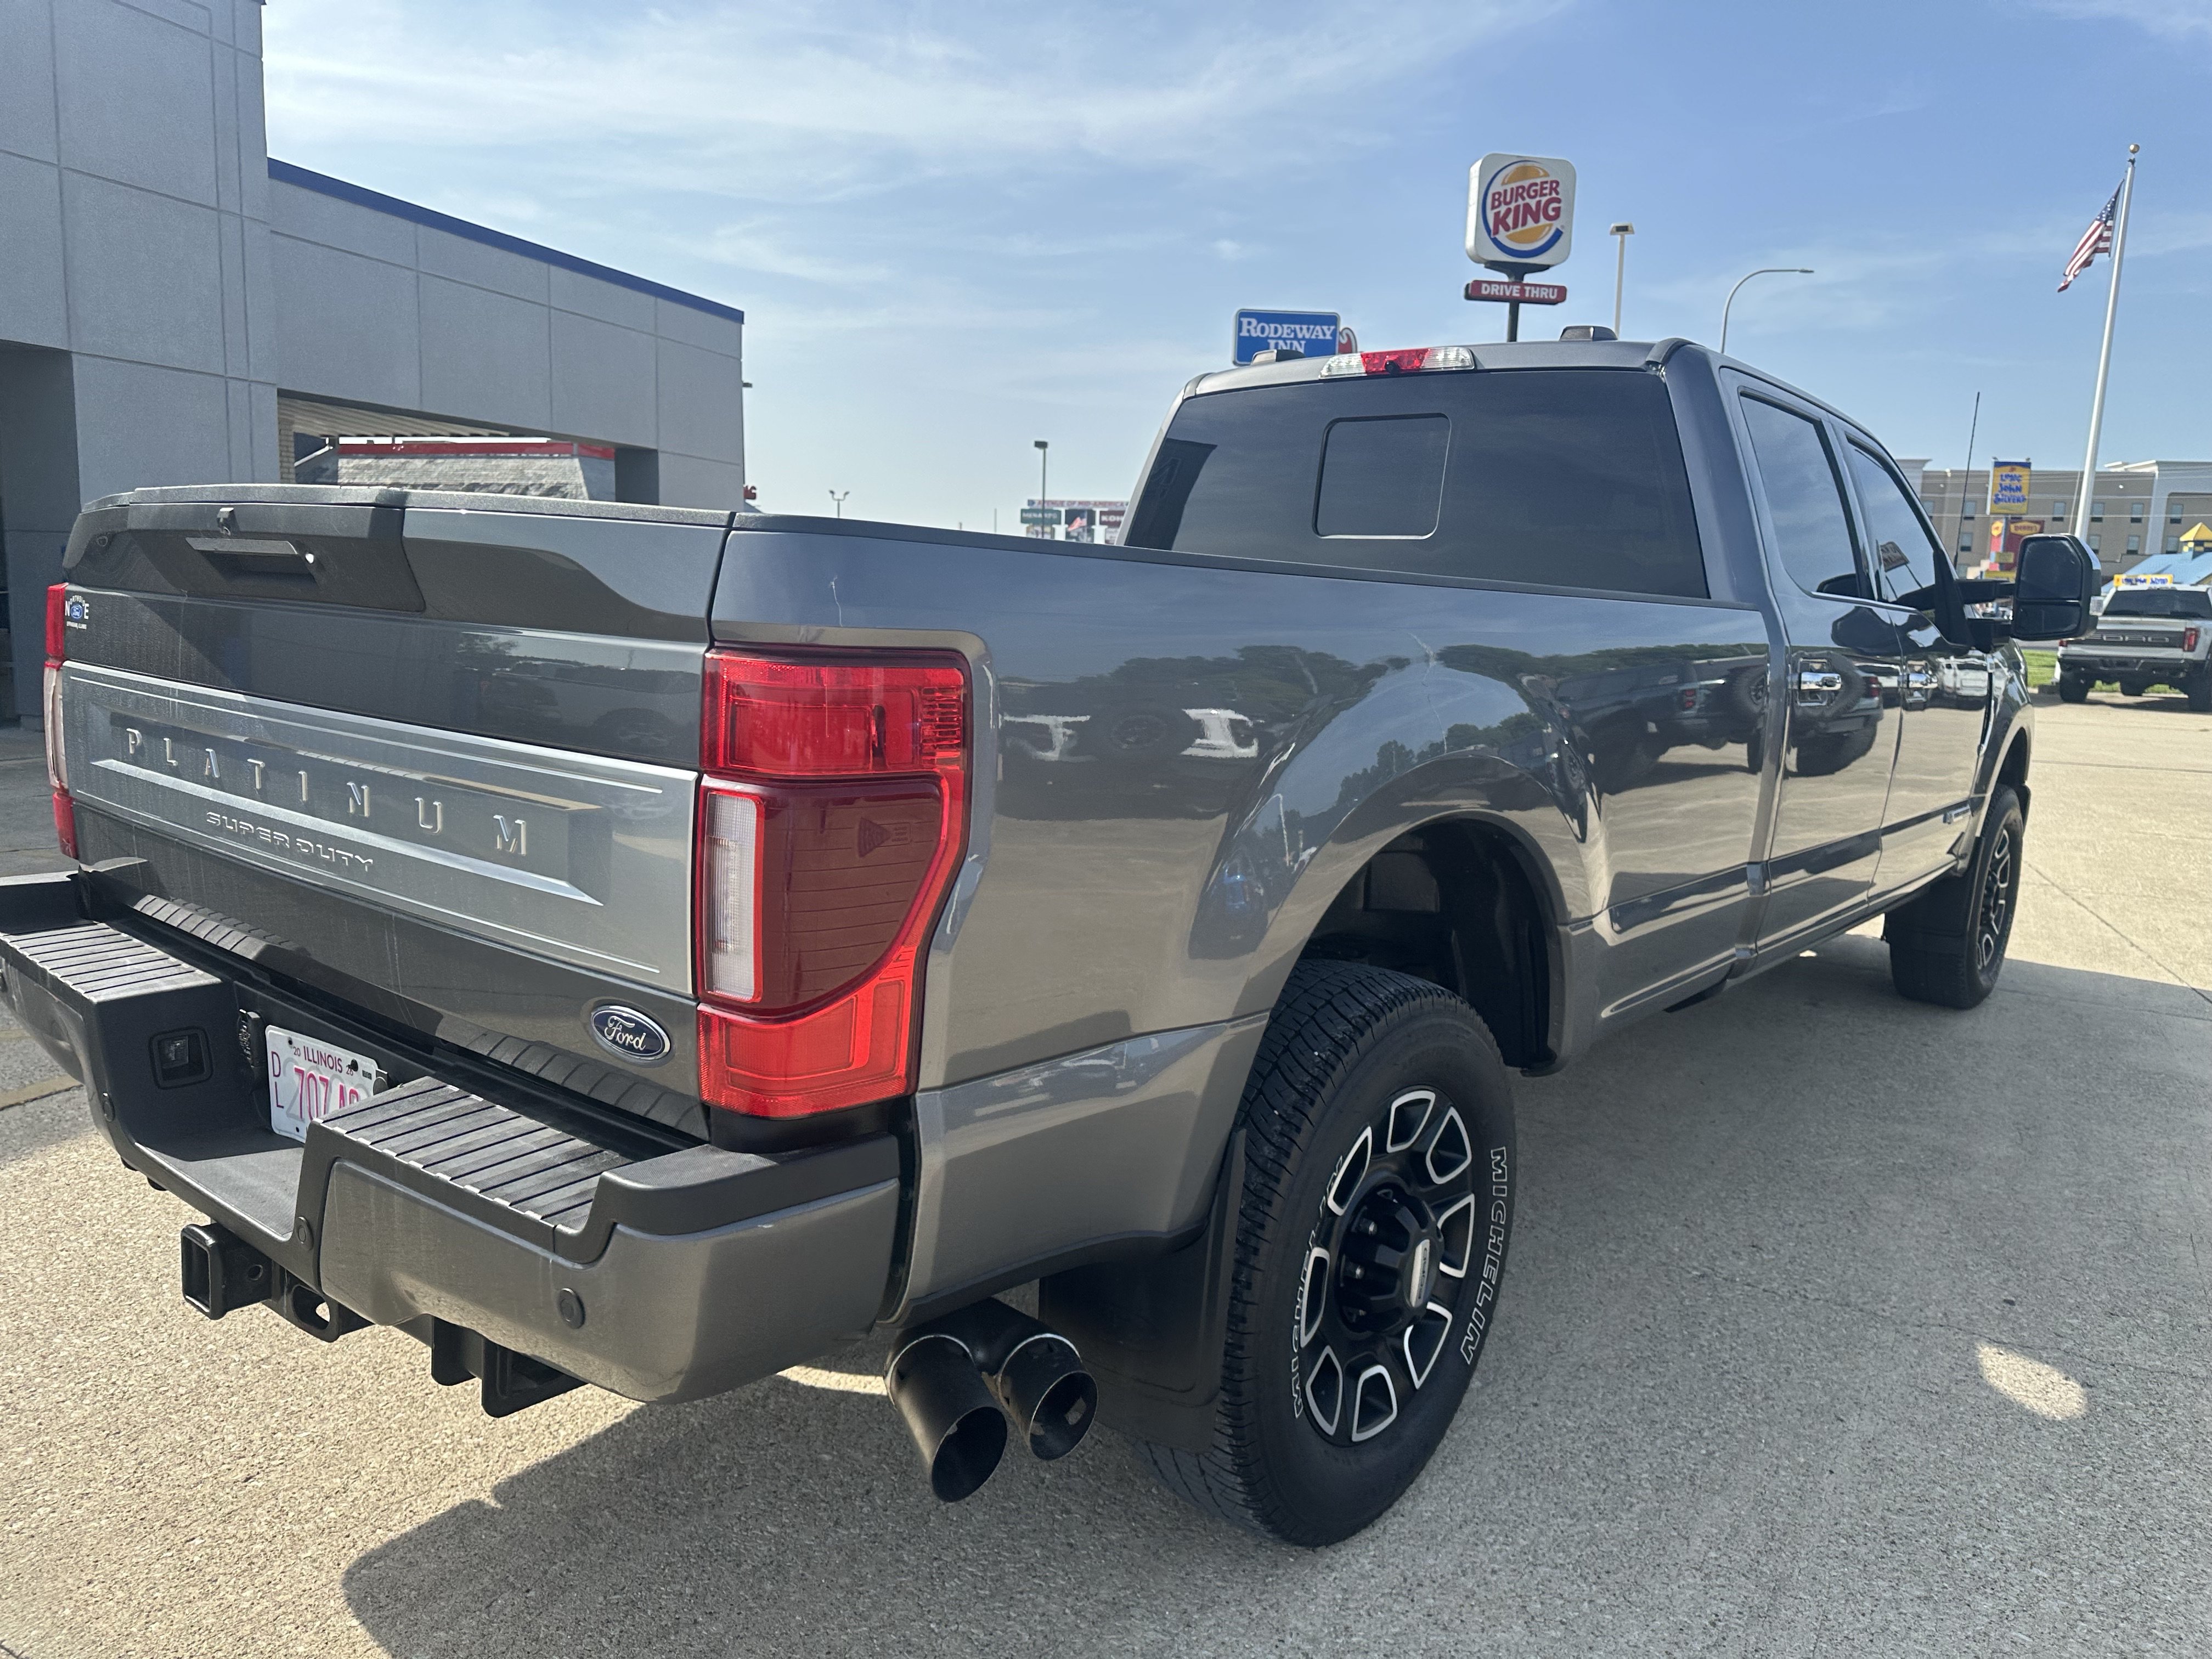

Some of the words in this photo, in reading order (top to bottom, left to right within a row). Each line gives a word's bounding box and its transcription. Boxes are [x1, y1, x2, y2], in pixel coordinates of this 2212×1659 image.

[1491, 179, 1560, 211] BURGER
[1492, 196, 1562, 236] KING
[1481, 284, 1520, 297] DRIVE
[1524, 286, 1558, 298] THRU
[1267, 339, 1306, 353] INN
[126, 727, 528, 856] PLATINUM
[206, 811, 290, 849] SUPER
[296, 838, 374, 872] DUTY
[604, 1015, 646, 1051] Ford
[293, 1046, 301, 1057] 20
[303, 1046, 343, 1074] ILLINOIS
[294, 1067, 329, 1121] 707
[1460, 1146, 1508, 1365] MICHELIN
